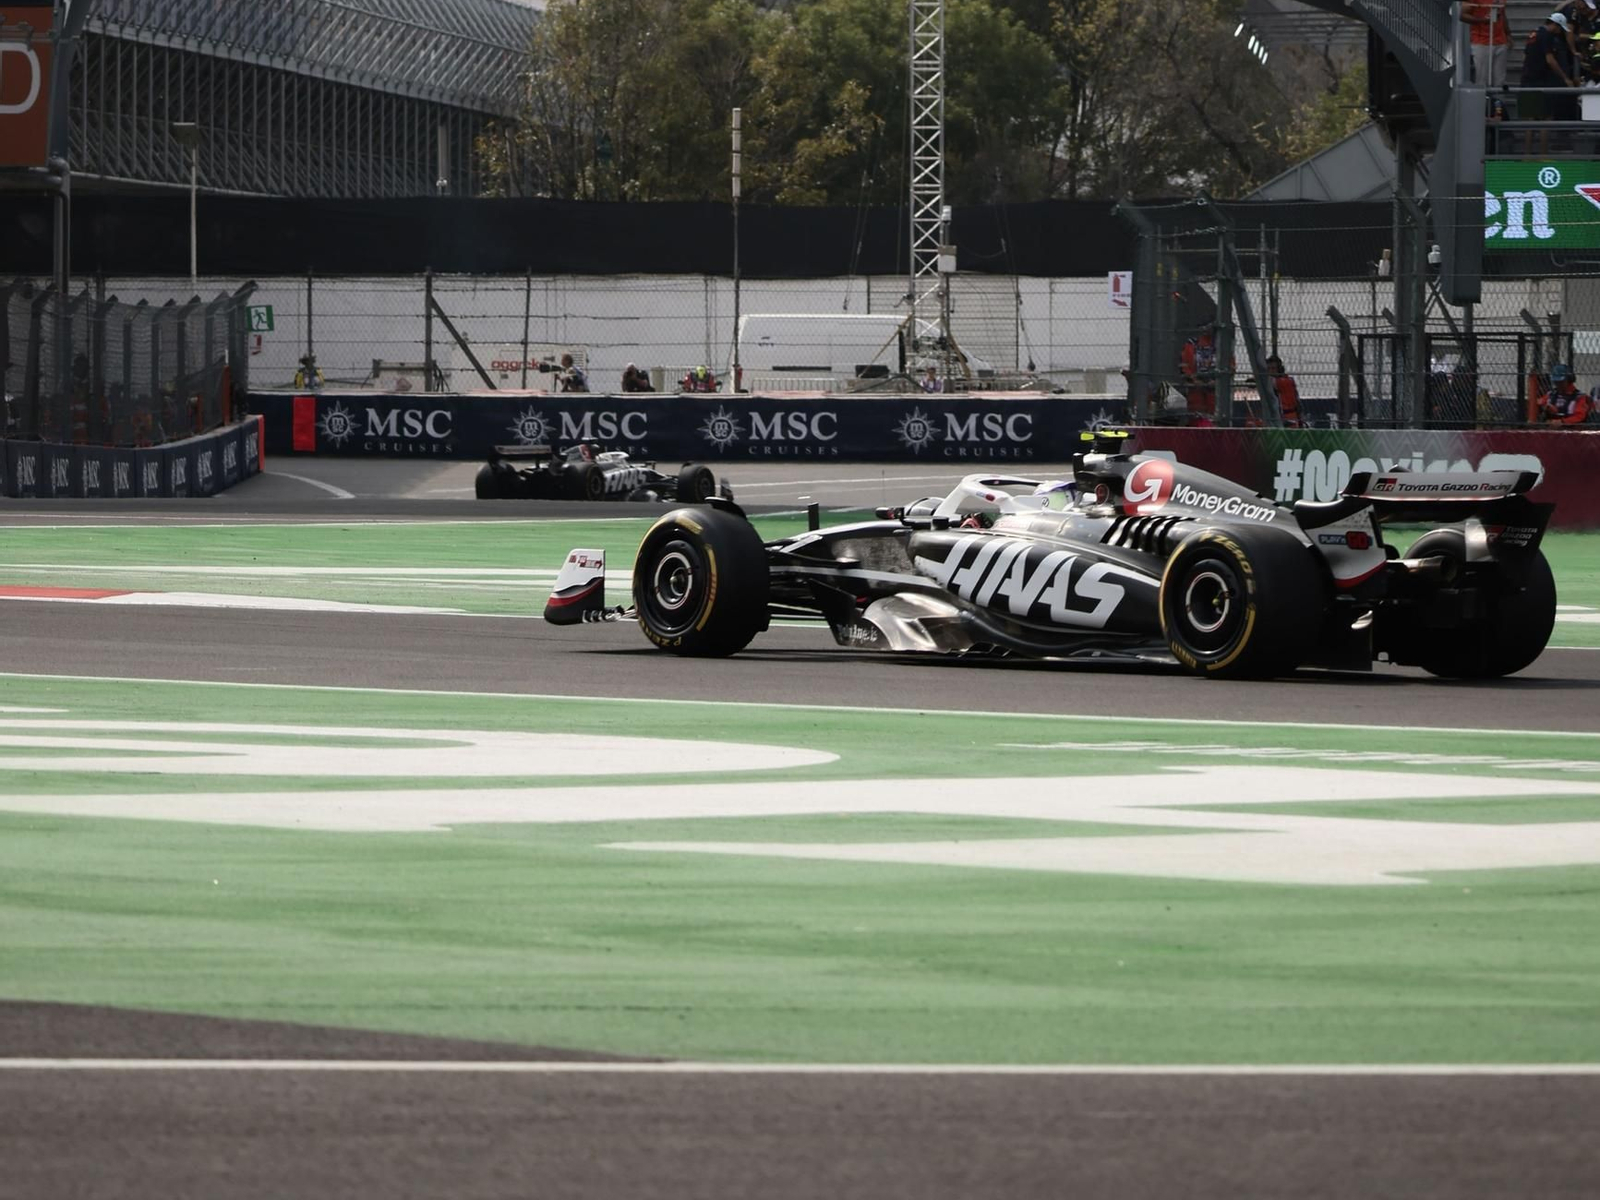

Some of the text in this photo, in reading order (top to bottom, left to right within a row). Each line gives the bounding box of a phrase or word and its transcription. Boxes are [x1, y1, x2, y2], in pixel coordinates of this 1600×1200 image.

[364, 408, 452, 439] MSC
[558, 411, 648, 440] MSC
[748, 411, 838, 441] MSC
[943, 412, 1033, 443] MSC
[364, 441, 453, 453] CRUISES
[748, 446, 839, 455] CRUISES
[943, 447, 1034, 457] CRUISES
[604, 469, 648, 493] HAAS
[1398, 483, 1439, 492] TOYOTA
[1441, 483, 1478, 491] GAZOO
[1480, 482, 1512, 492] Racing
[1170, 483, 1276, 522] MoneyGram
[915, 535, 1161, 629] HAAS
